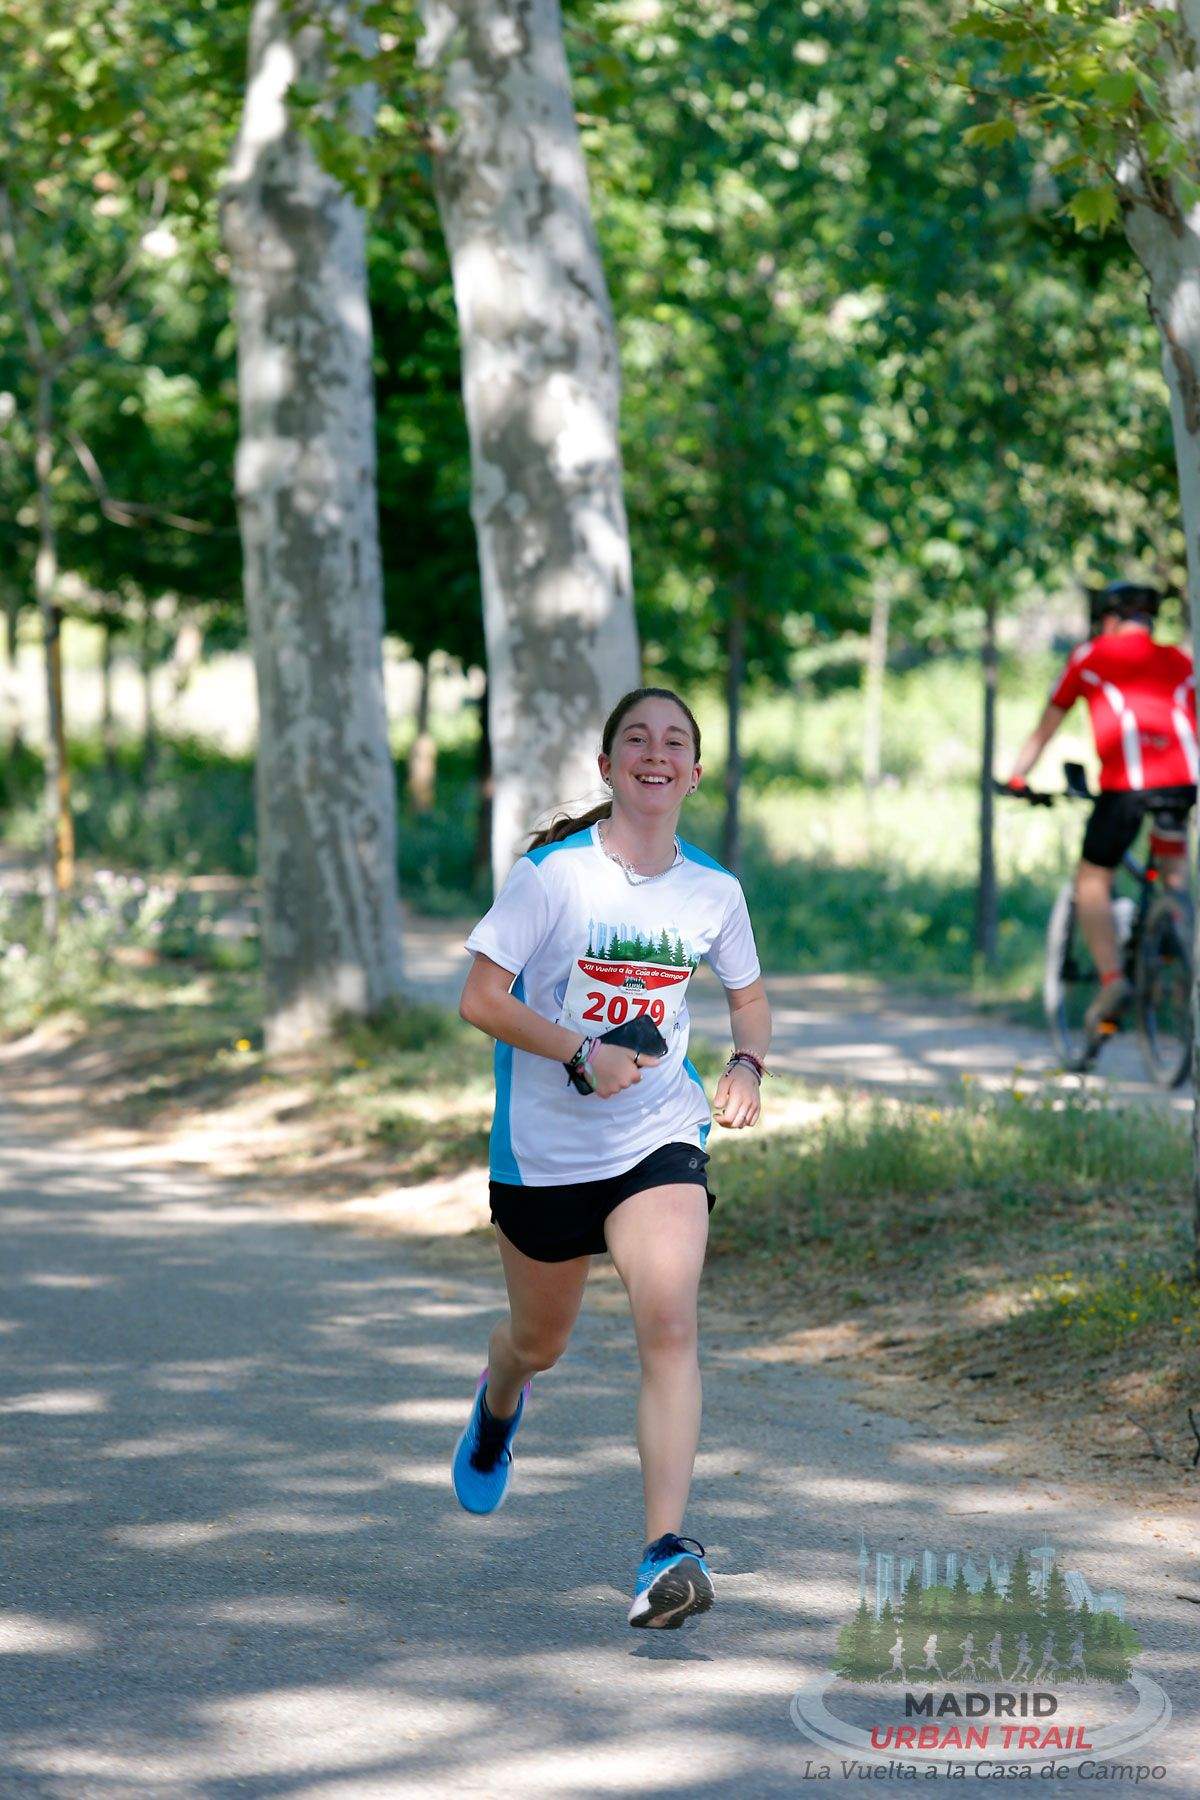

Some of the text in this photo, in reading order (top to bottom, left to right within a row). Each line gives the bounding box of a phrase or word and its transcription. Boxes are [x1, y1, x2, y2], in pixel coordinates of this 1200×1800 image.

[595, 965, 618, 974] Vuelta
[625, 967, 633, 975] la
[660, 972, 684, 981] Campo
[582, 991, 665, 1028] 2079
